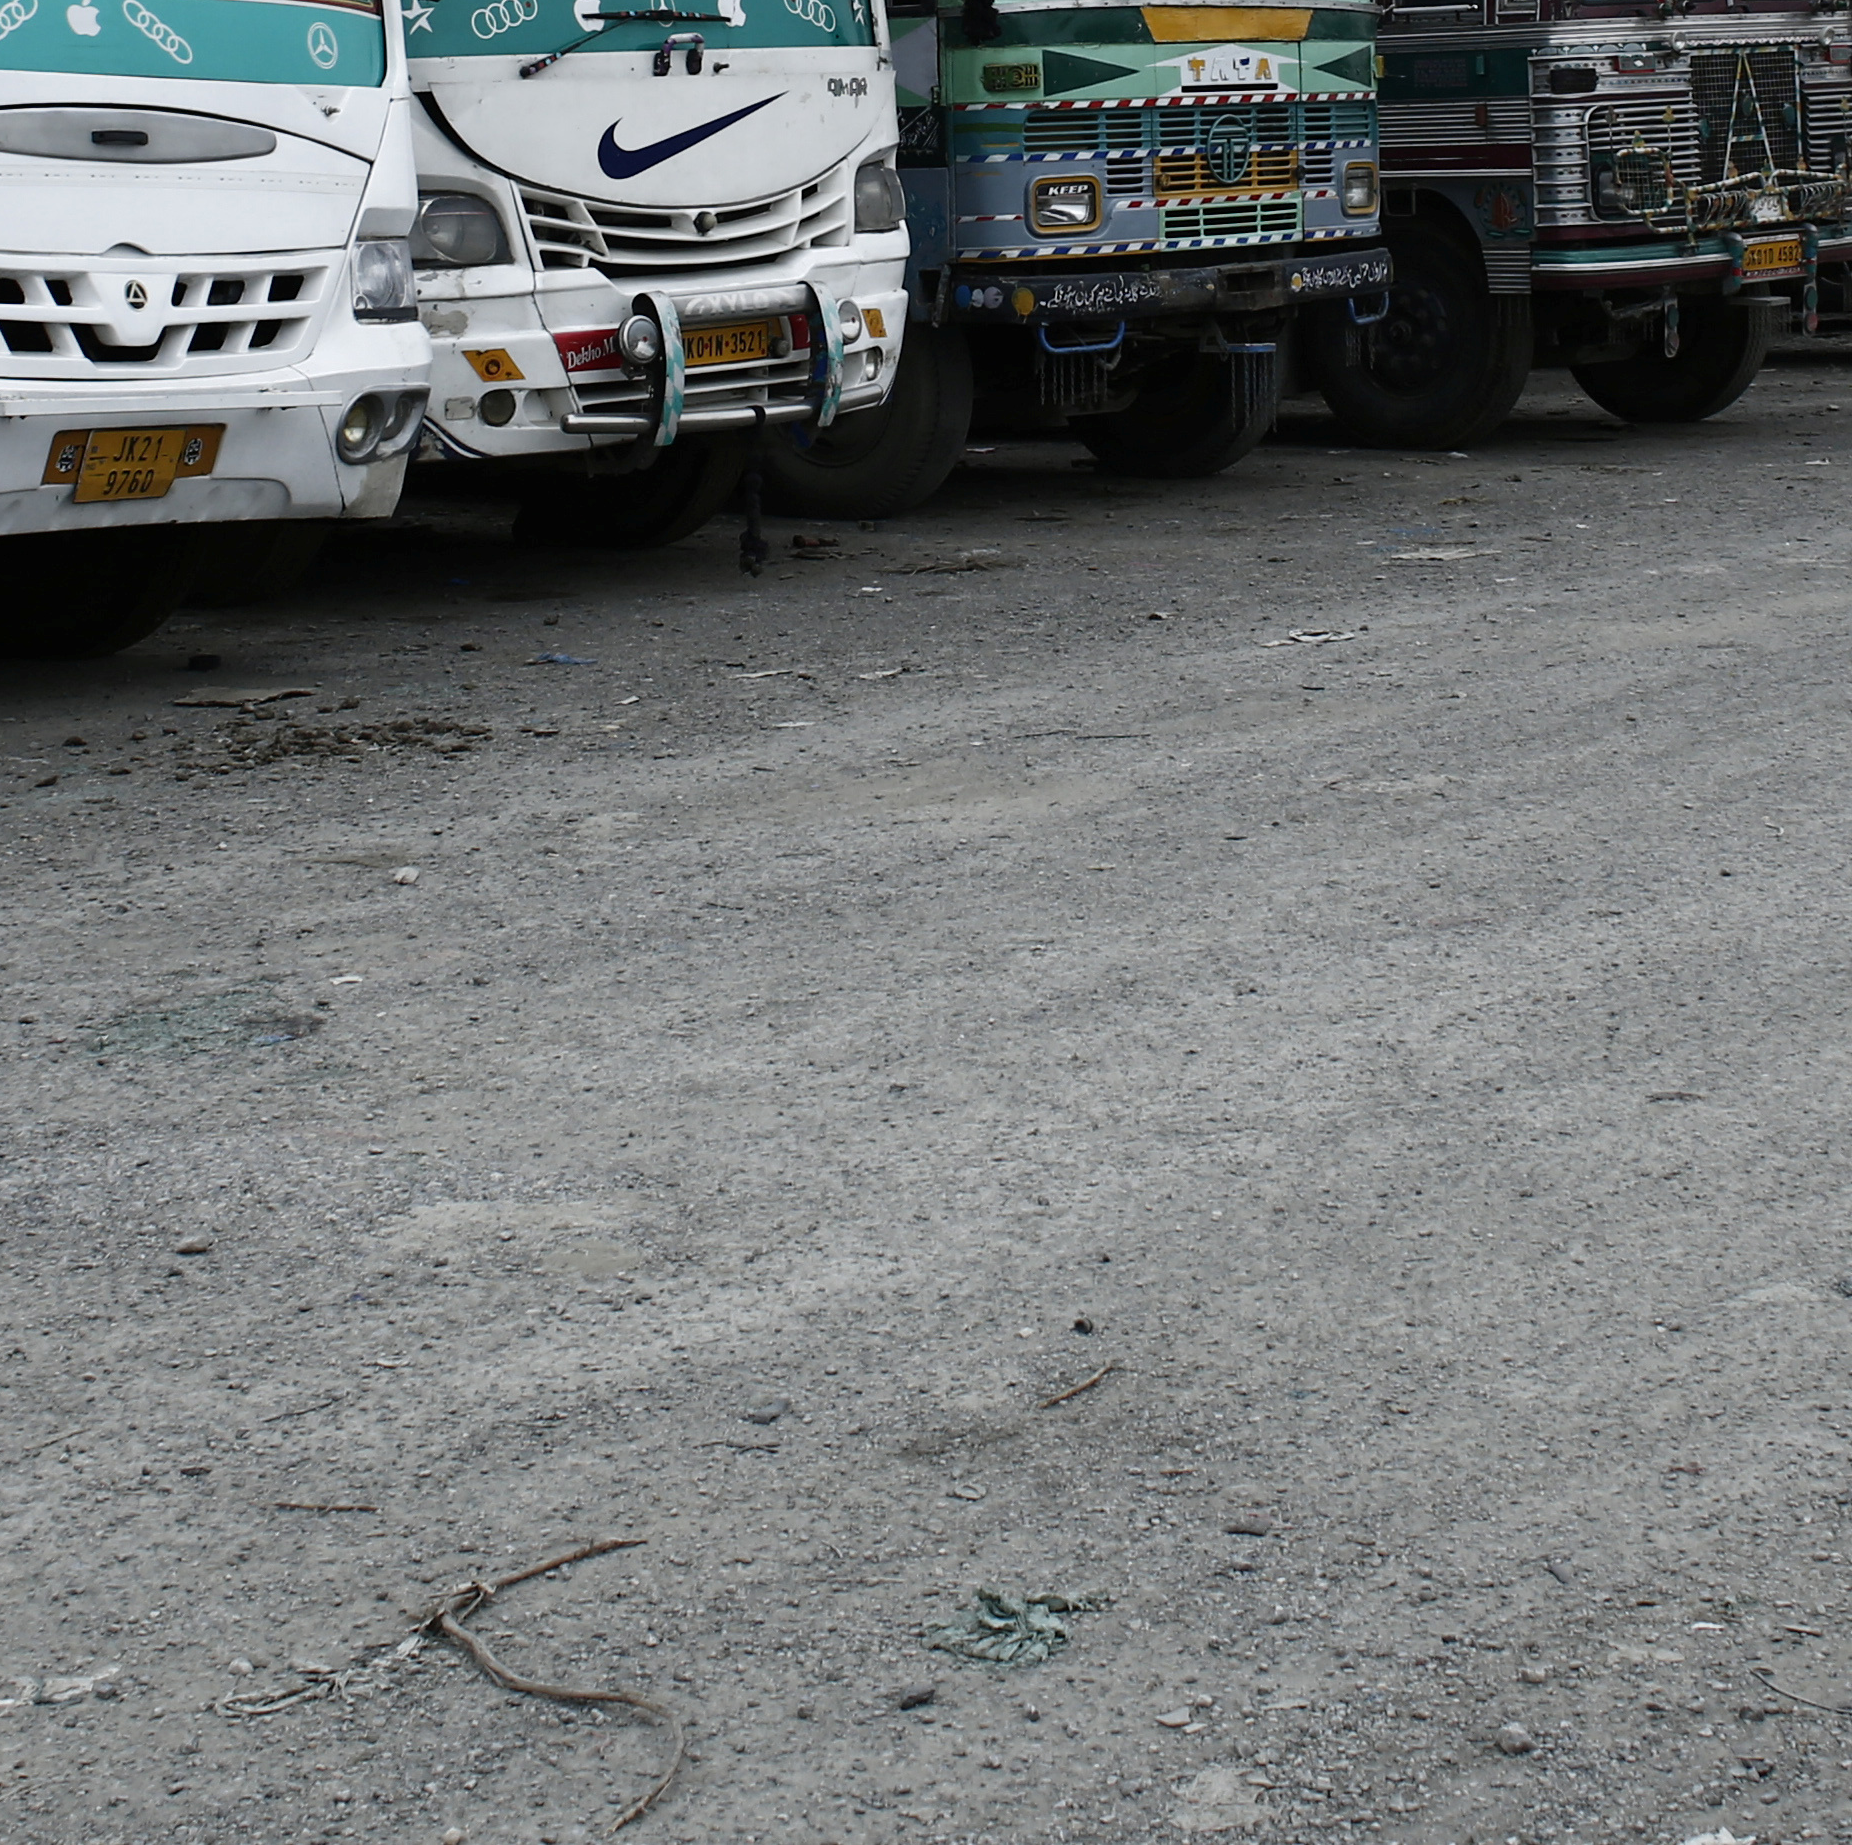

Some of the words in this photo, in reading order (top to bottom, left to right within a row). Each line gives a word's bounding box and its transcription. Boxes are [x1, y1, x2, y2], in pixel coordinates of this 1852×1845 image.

[1188, 57, 1273, 81] TATA
[1048, 184, 1089, 196] KEEP
[567, 345, 602, 369] Dekho
[102, 468, 155, 496] 9760
